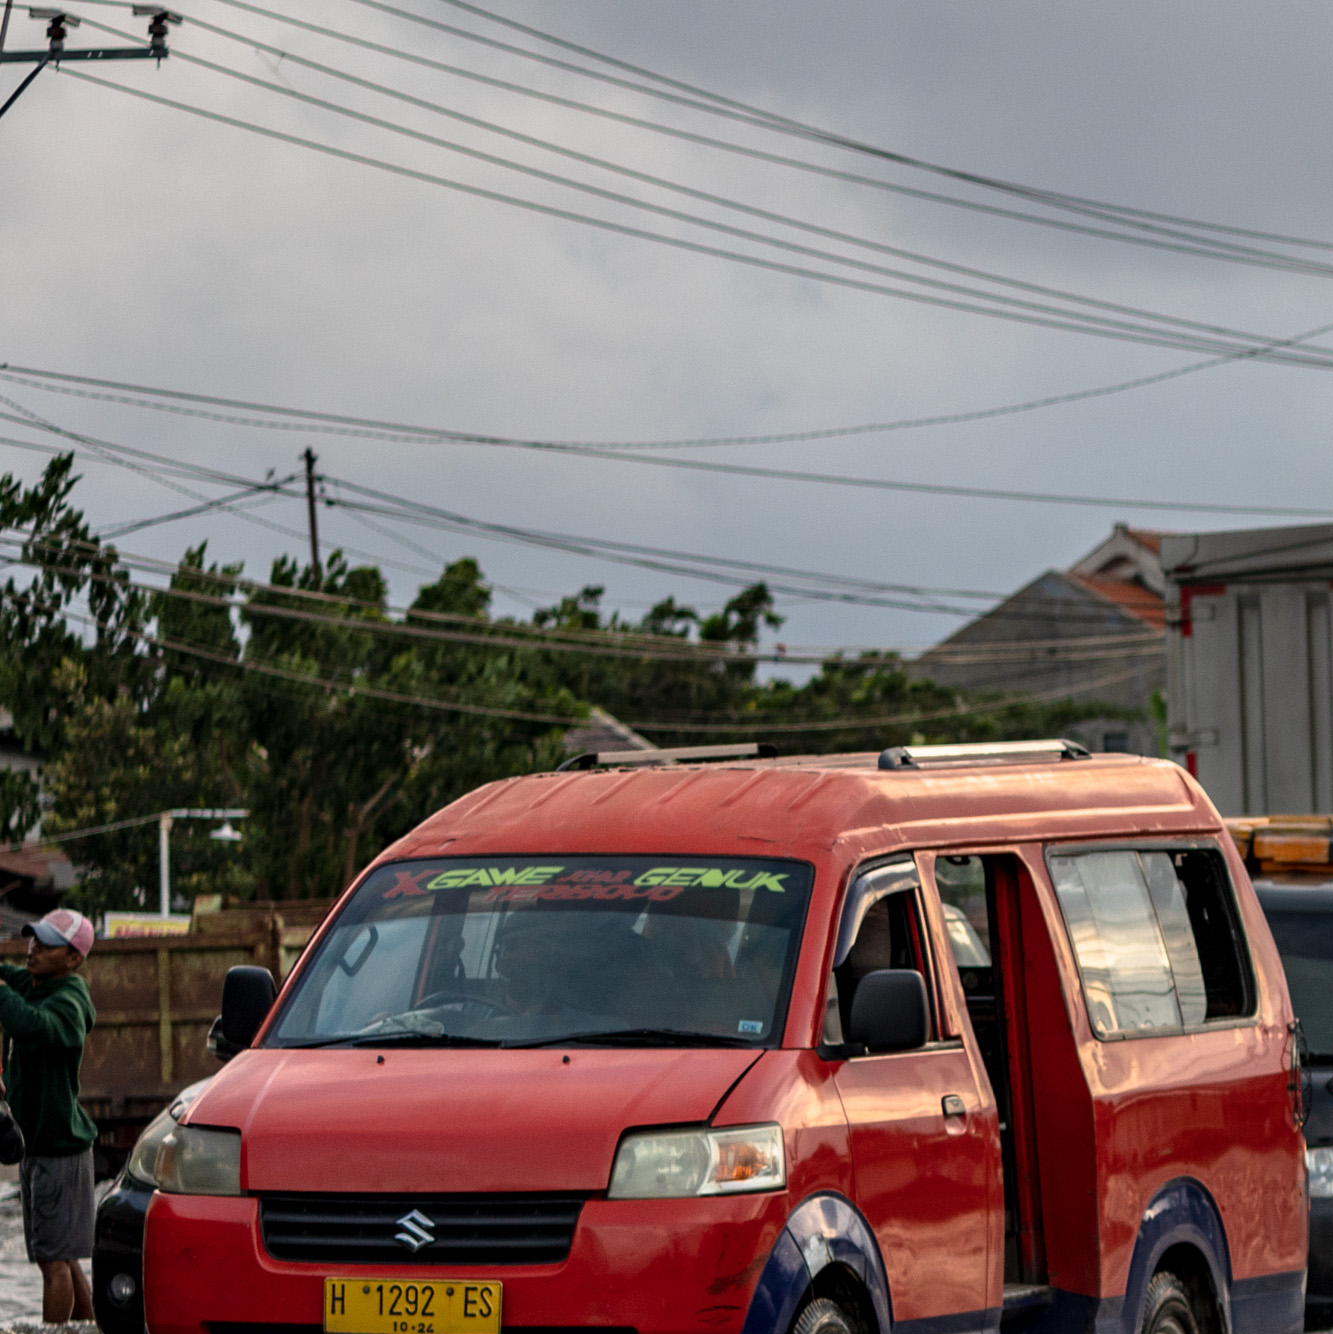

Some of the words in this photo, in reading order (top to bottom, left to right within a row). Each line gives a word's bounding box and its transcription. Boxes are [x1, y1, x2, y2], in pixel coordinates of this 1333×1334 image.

[633, 867, 790, 893] GENUK
[331, 1284, 345, 1315] H
[376, 1285, 434, 1316] 1292
[463, 1286, 493, 1318] ES
